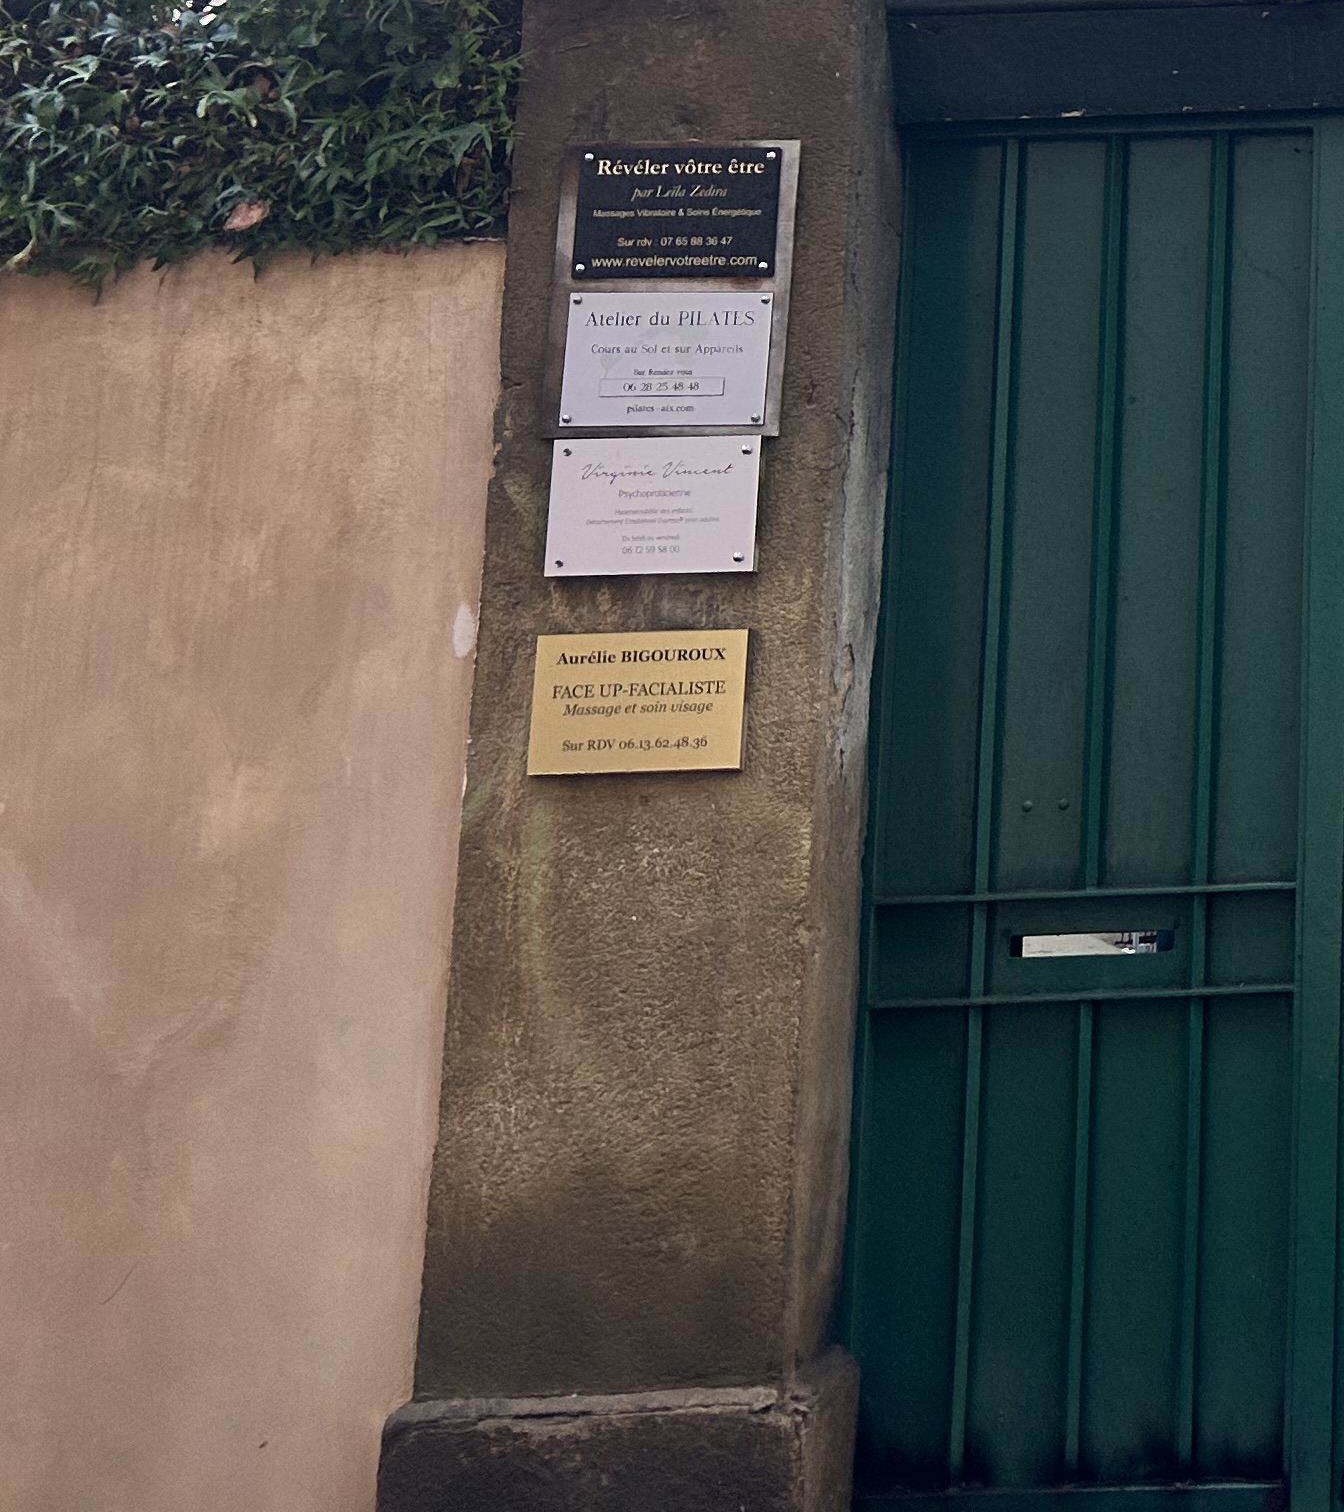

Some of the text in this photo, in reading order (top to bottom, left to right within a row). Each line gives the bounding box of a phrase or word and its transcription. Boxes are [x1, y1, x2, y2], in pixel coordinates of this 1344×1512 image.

[597, 158, 765, 175] Révéler vôtre être
[631, 188, 653, 202] par
[593, 209, 635, 219] Massages
[636, 208, 676, 217] Vibratoire
[678, 208, 684, 216] &
[686, 208, 710, 216] Soins
[617, 237, 635, 247] Sur
[636, 237, 652, 247] rdv
[660, 237, 673, 246] 07
[675, 237, 689, 246] 65
[720, 236, 733, 246] 47
[591, 255, 757, 268] www.revelervotreetre.com
[585, 310, 755, 327] Atelier du PILATES
[591, 344, 744, 356] Cours au Sol et sur Appareils
[622, 383, 636, 391] 06
[656, 383, 668, 391] 25
[581, 462, 654, 485] Virginie
[556, 647, 727, 666] Aurélie BIGOUROUX
[552, 680, 726, 700] FACE UP-FACIALISTE
[563, 700, 714, 717] Massage et soin visage
[562, 735, 708, 752] Sur RDV 06.13.62.48.36
